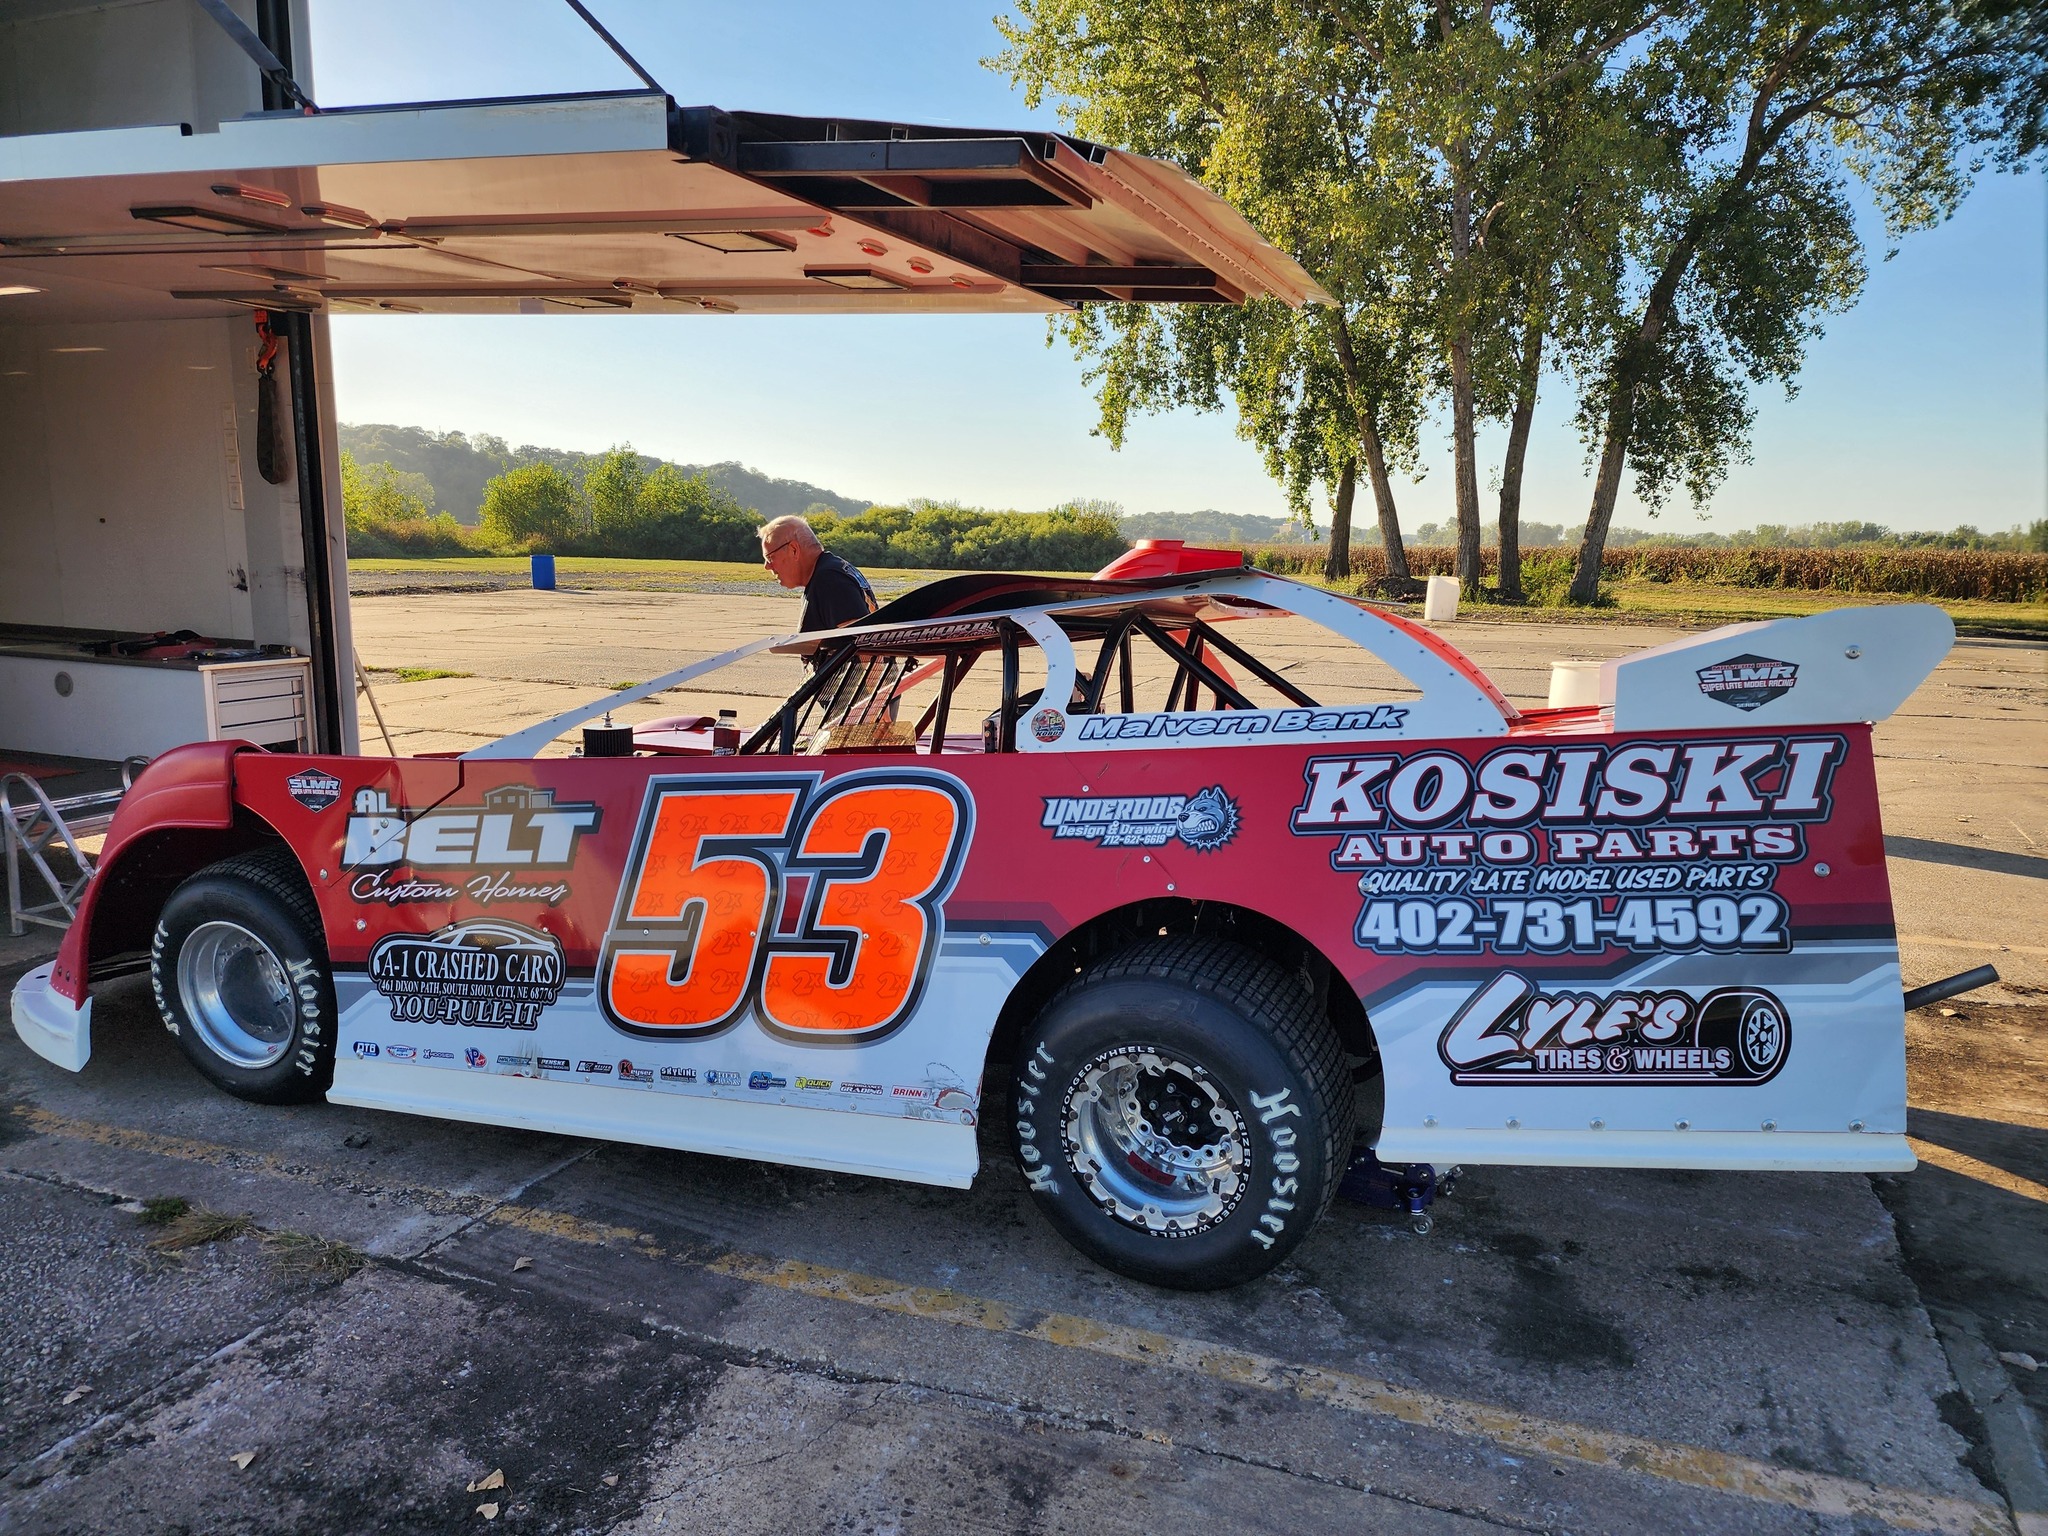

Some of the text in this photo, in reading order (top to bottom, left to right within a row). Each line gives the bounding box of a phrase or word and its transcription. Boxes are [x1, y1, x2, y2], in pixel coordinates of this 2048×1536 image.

[1700, 665, 1795, 682] SLMR
[1702, 679, 1794, 693] SUPER LATE MODEL RACING
[1079, 706, 1410, 740] Malvern Bank
[289, 779, 339, 790] SLMR
[1296, 740, 1837, 824] KOSISKI
[355, 789, 397, 813] AL
[1043, 797, 1187, 826] UNDERDOG
[343, 811, 597, 865] BELT
[1056, 823, 1177, 838] Design & Drawing
[1101, 835, 1167, 846] 712-621-6619
[1336, 824, 1798, 864] AUTO PARTS
[352, 869, 567, 903] Custom Homes
[1369, 865, 1771, 895] QUALITY LATE MODEL USED PARTS
[601, 774, 968, 1042] 53
[1361, 898, 1781, 946] 402-731-4592
[381, 949, 555, 984] A-1 CRASHED CARS
[380, 982, 553, 1000] 461 DIXON PATH, SOUTH SIOUX CITY, NE 68776
[285, 958, 325, 1076] Hoosier
[392, 995, 539, 1026] YOU-PULL-IT
[541, 1058, 566, 1067] PENSKE
[661, 1066, 697, 1078] SKYLINE
[1534, 1048, 1730, 1070] TIRES & WHEELS
[807, 1079, 832, 1088] QUICK
[840, 1086, 883, 1096] GRADING
[893, 1088, 923, 1098] BRINN
[1016, 1041, 1059, 1195] Hoosier
[1060, 1045, 1156, 1173] KEIZER FORGED WHEELS
[1150, 1110, 1251, 1238] KEIZER FORGED WHEELS
[1251, 1087, 1302, 1250] Hoosier
